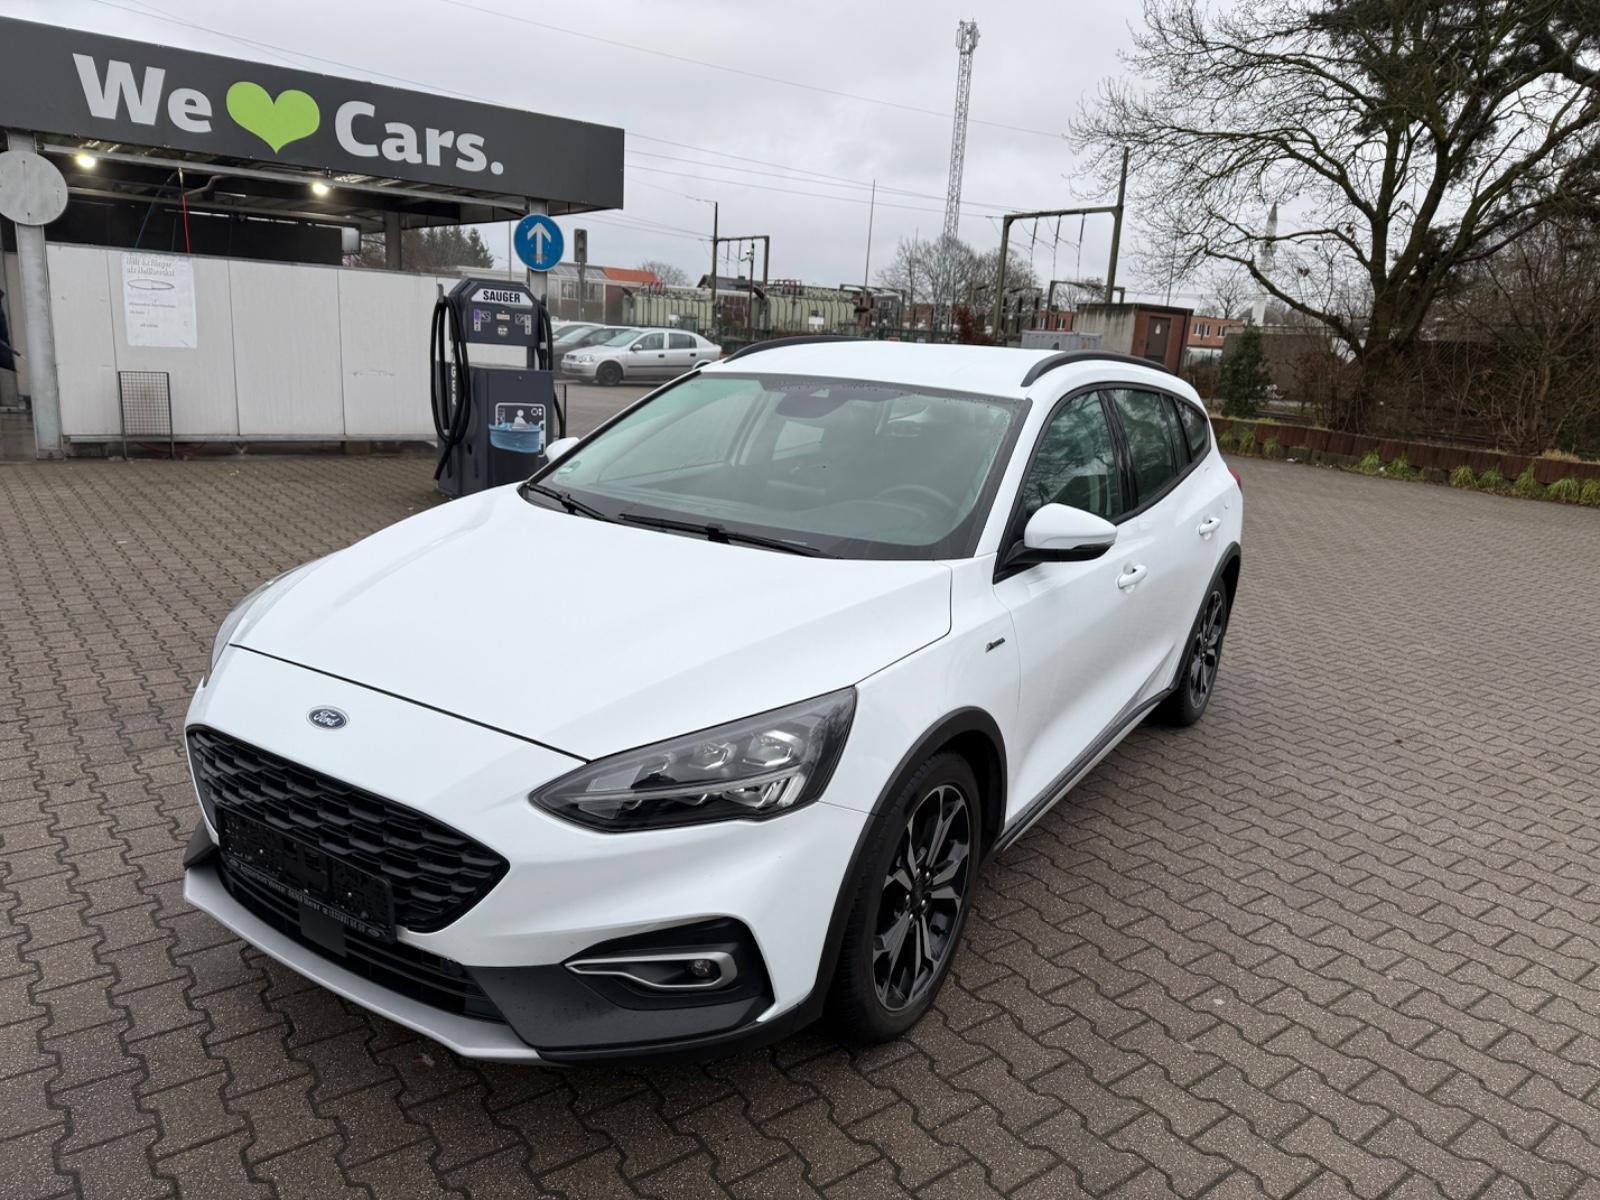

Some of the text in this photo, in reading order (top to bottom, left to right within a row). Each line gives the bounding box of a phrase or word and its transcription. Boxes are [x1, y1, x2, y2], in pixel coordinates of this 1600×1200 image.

[72, 52, 505, 176] We Cars.
[483, 289, 521, 303] SAUGER
